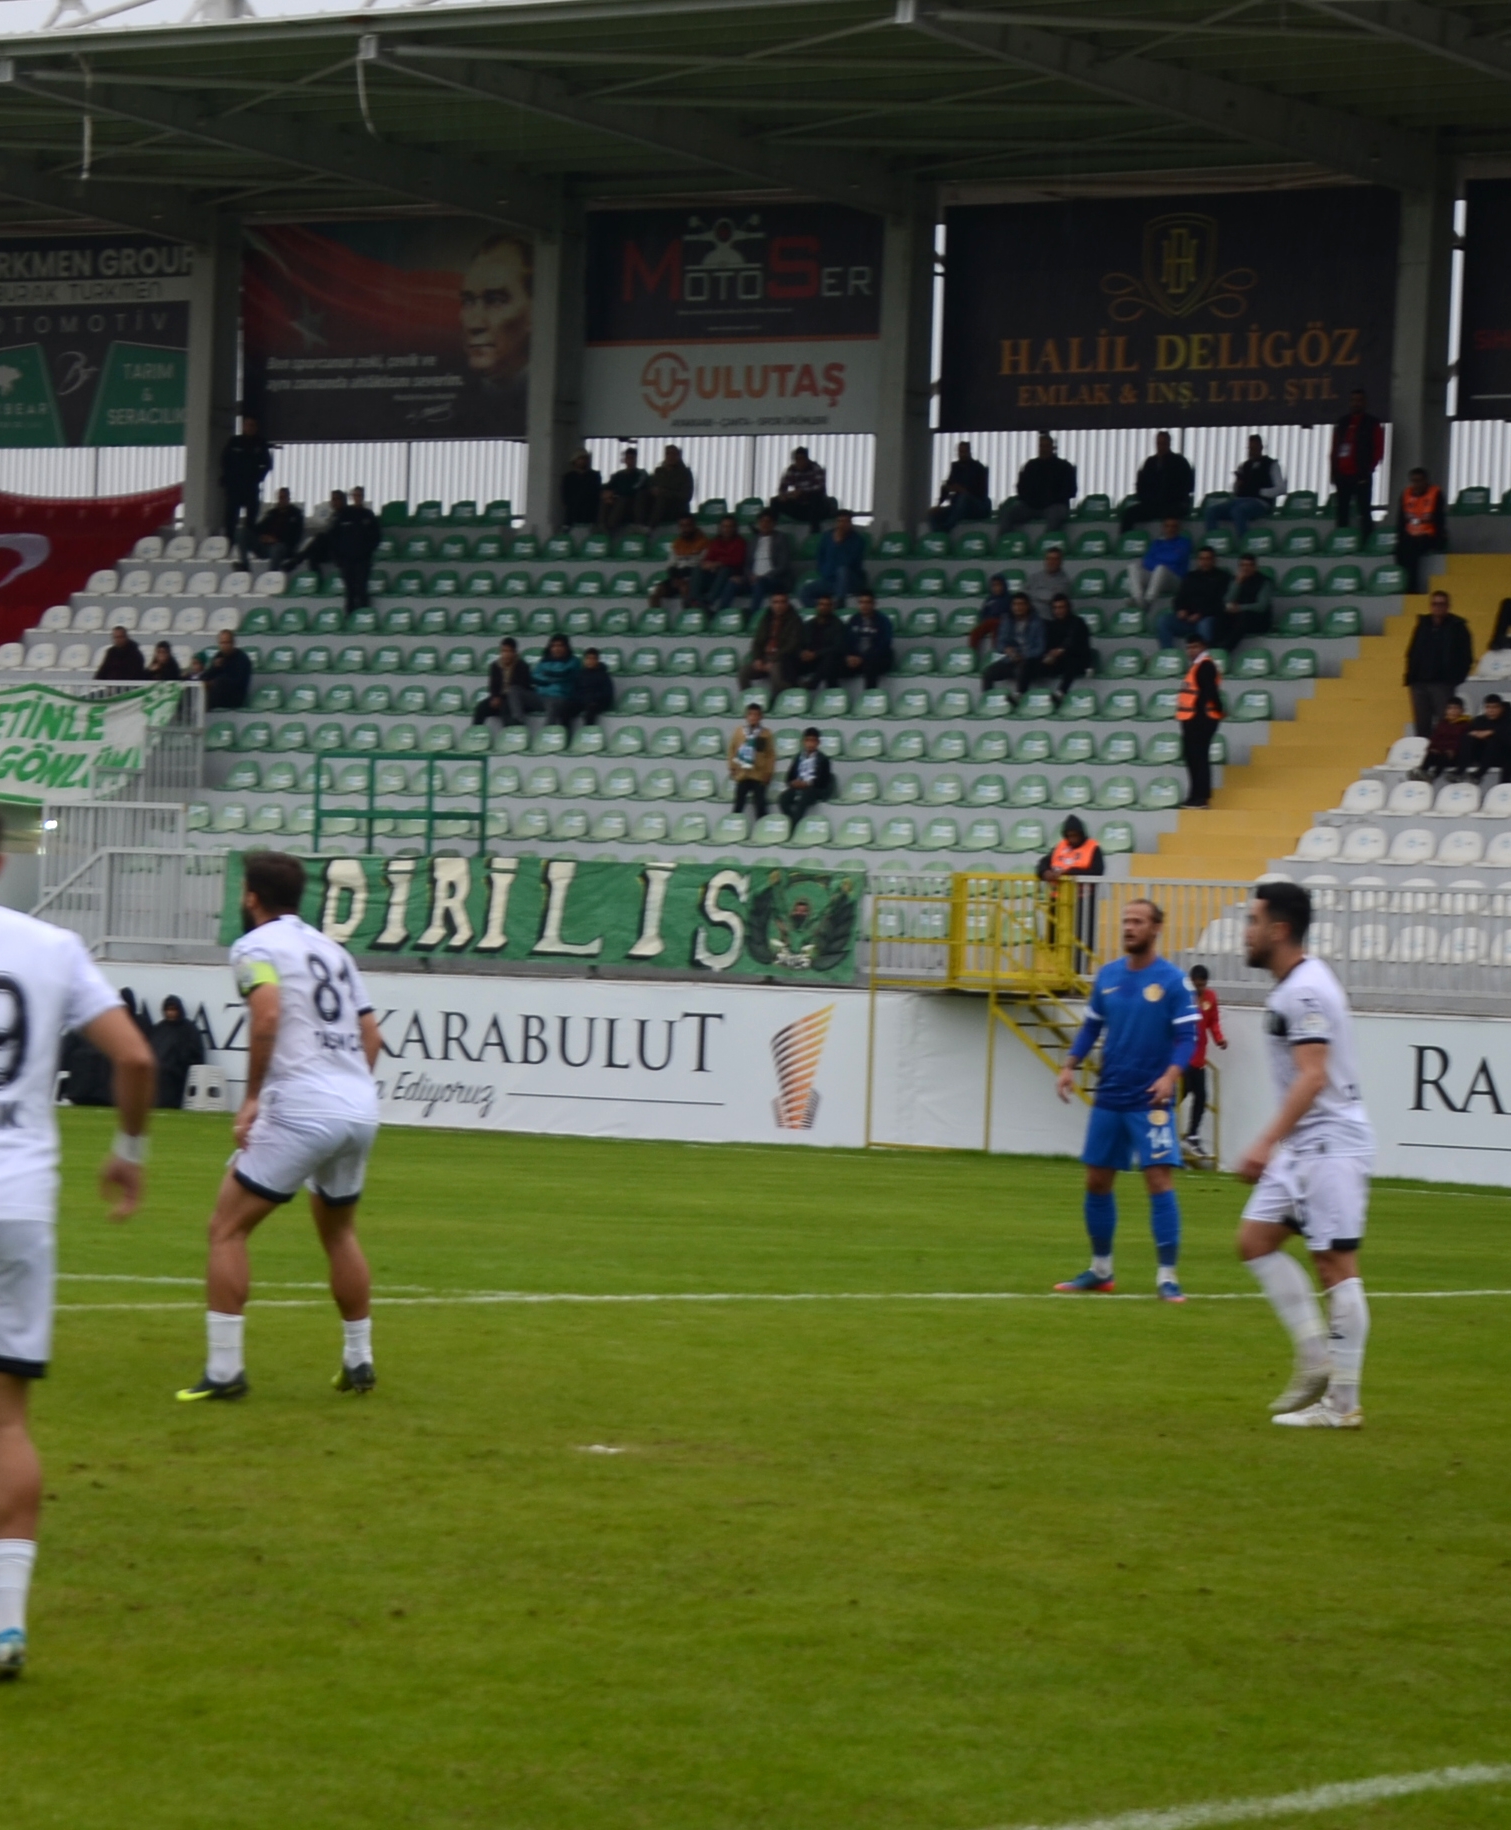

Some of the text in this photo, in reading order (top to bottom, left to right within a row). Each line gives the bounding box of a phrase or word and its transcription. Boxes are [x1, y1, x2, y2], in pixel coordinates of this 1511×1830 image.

[998, 321, 1362, 376] HALİL DELİGÖZ
[696, 363, 847, 408] ULUTAŞ
[1017, 384, 1111, 408] EMLAK
